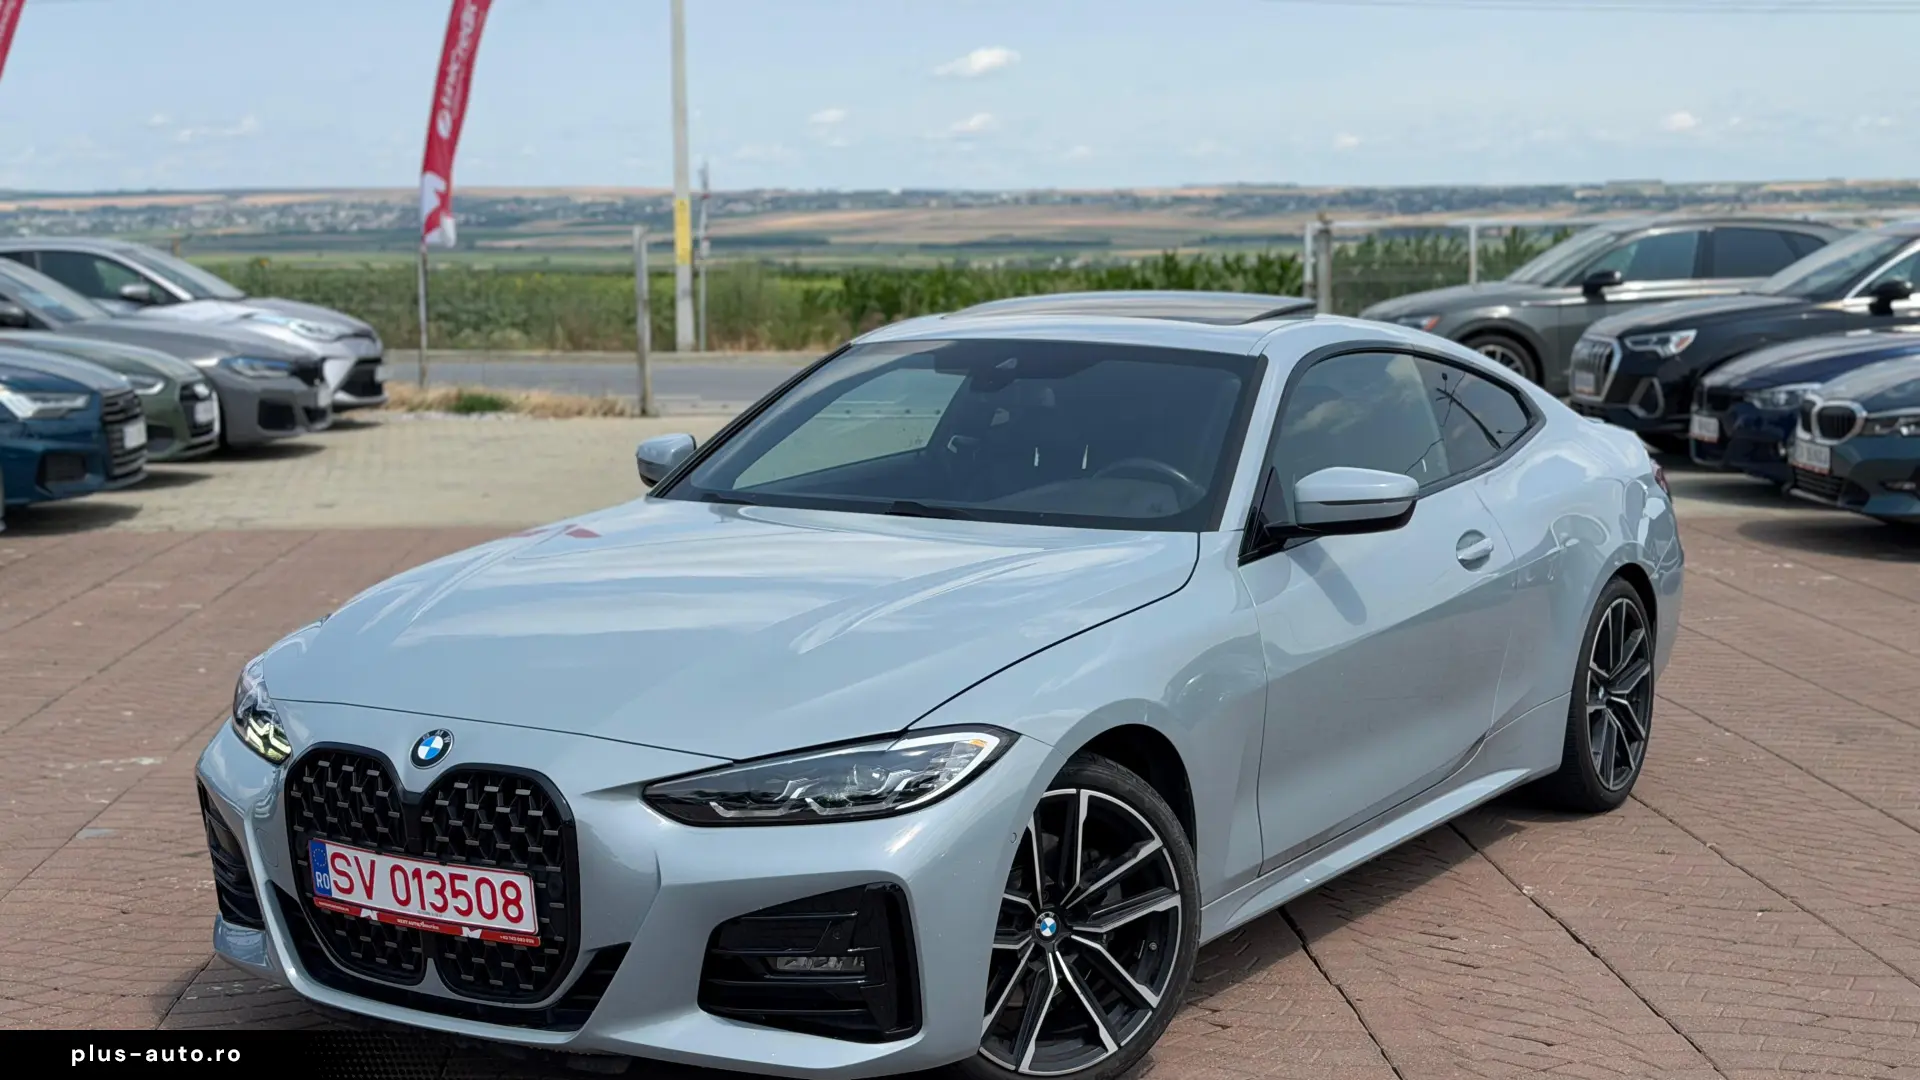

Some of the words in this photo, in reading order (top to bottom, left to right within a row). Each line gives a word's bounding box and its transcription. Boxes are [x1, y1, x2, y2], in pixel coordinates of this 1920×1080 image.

[315, 871, 330, 890] RO
[330, 852, 376, 901] SV
[389, 864, 524, 924] 013508
